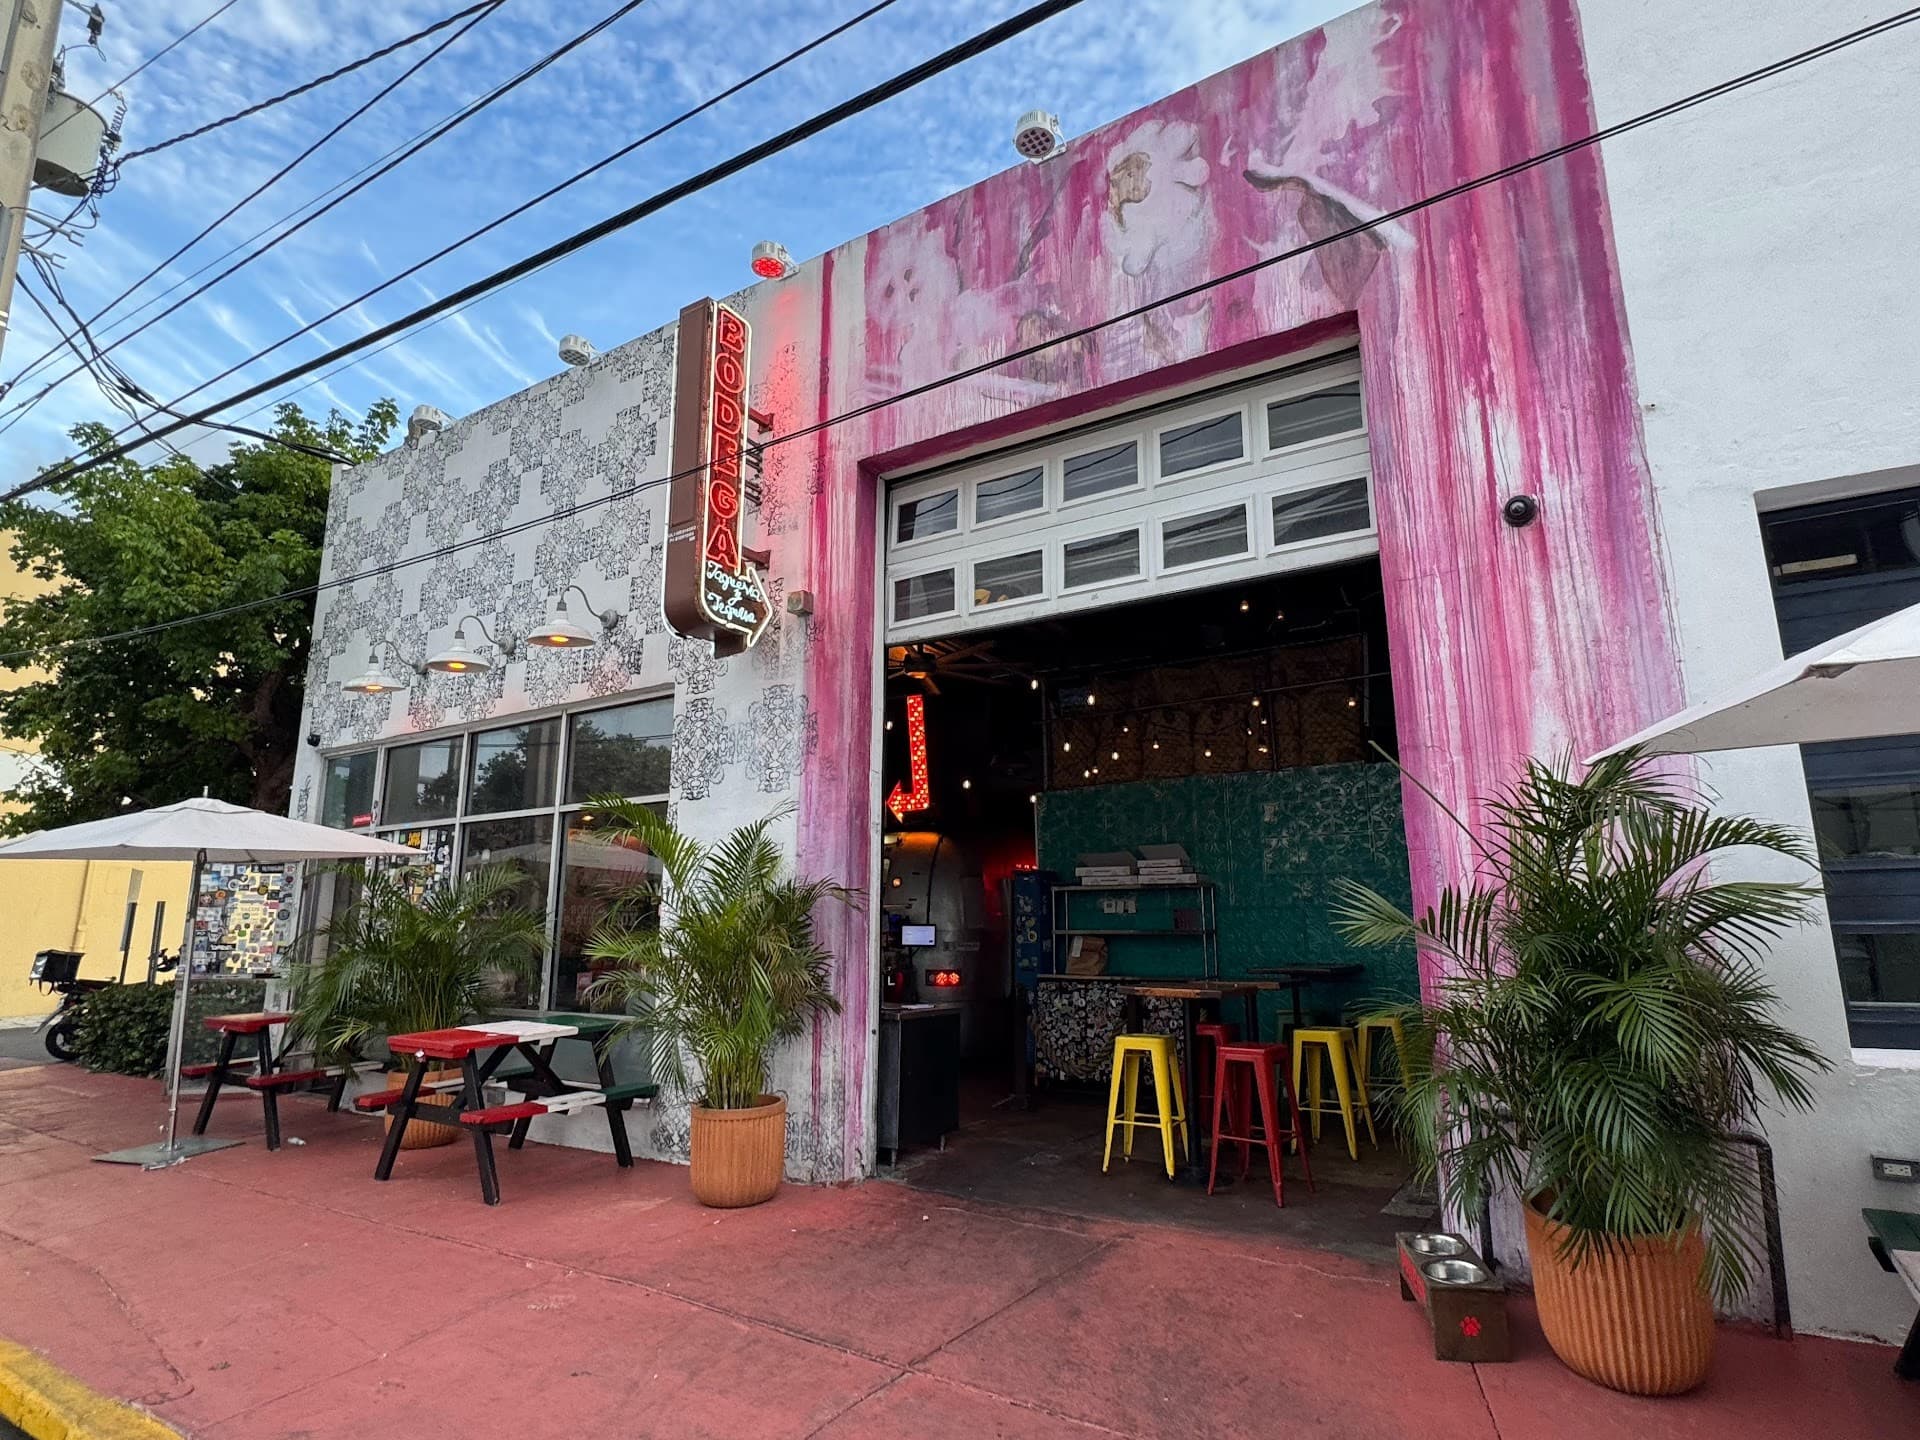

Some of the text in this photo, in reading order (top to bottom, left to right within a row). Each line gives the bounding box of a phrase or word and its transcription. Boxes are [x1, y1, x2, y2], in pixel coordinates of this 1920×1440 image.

[706, 311, 744, 569] BODEGA
[706, 560, 762, 602] Taqueria
[728, 588, 742, 605] y
[707, 592, 757, 623] Tequila
